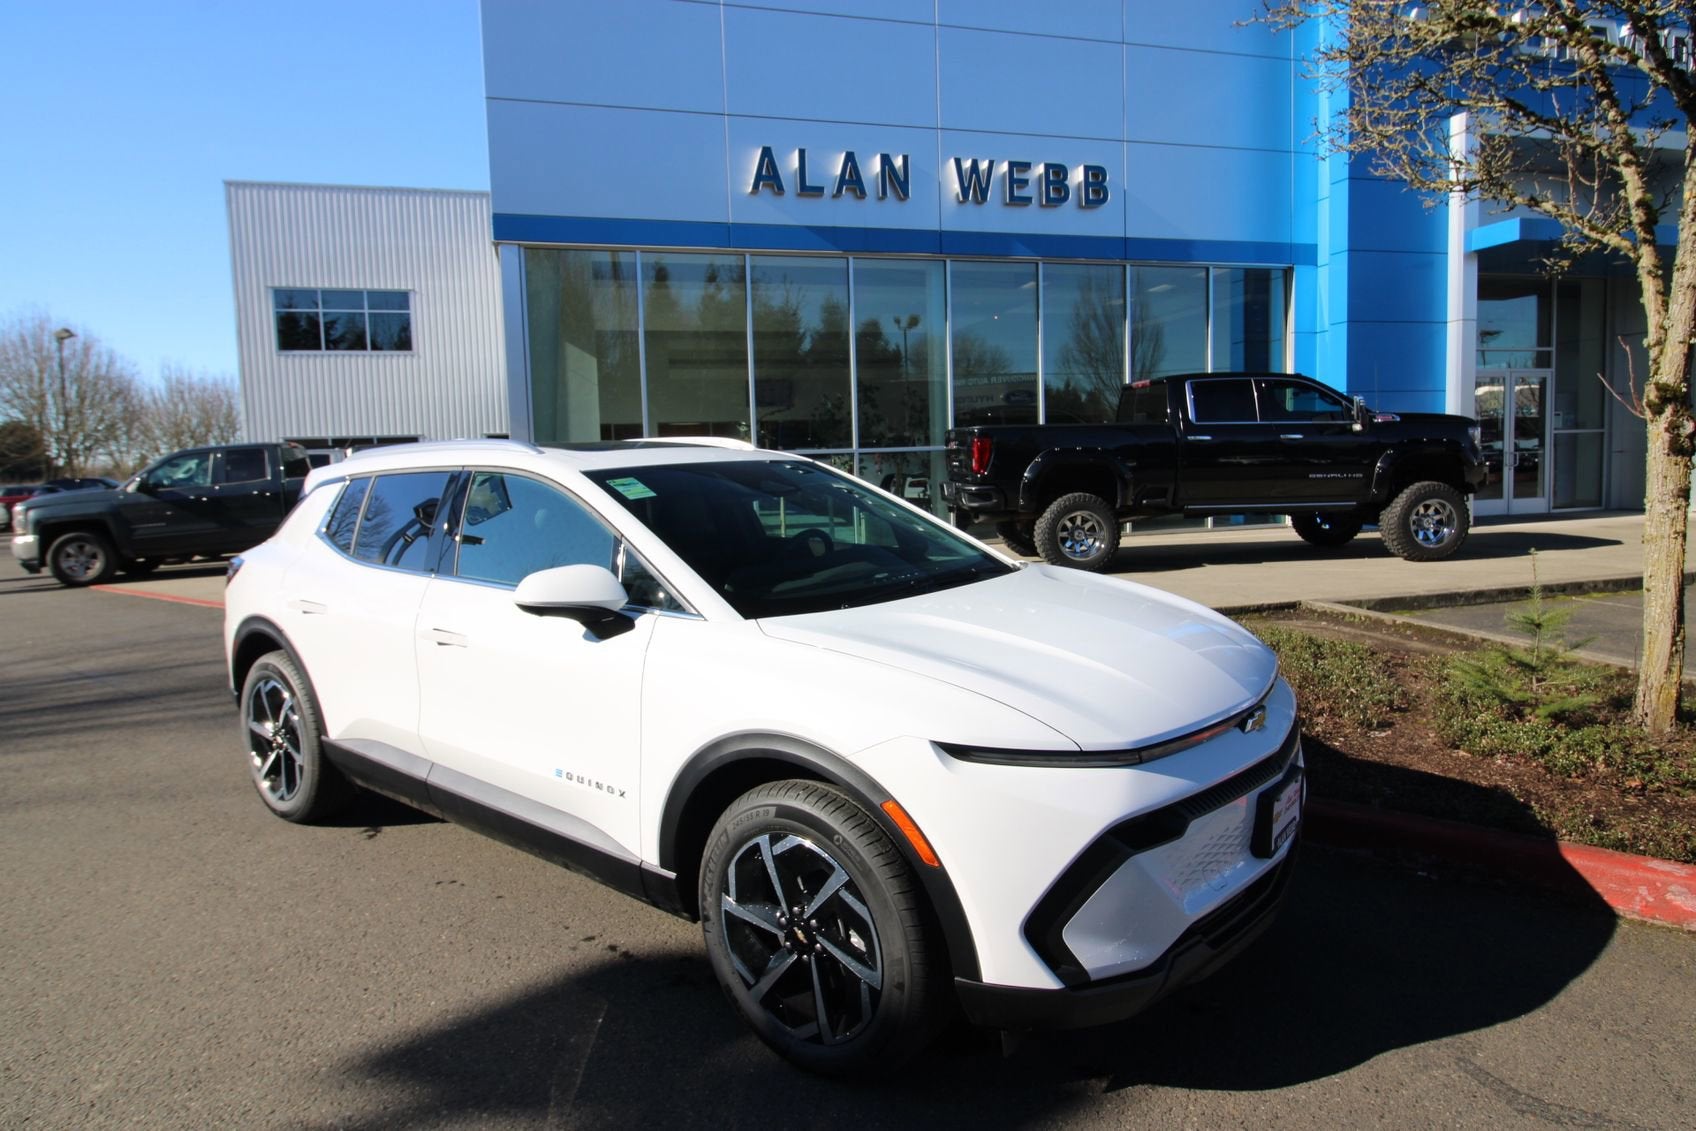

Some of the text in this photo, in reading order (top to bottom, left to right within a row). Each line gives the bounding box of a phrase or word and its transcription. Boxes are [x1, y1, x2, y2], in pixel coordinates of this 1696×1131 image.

[749, 145, 1111, 208] ALAN WEBB
[555, 768, 627, 799] EQUINOX
